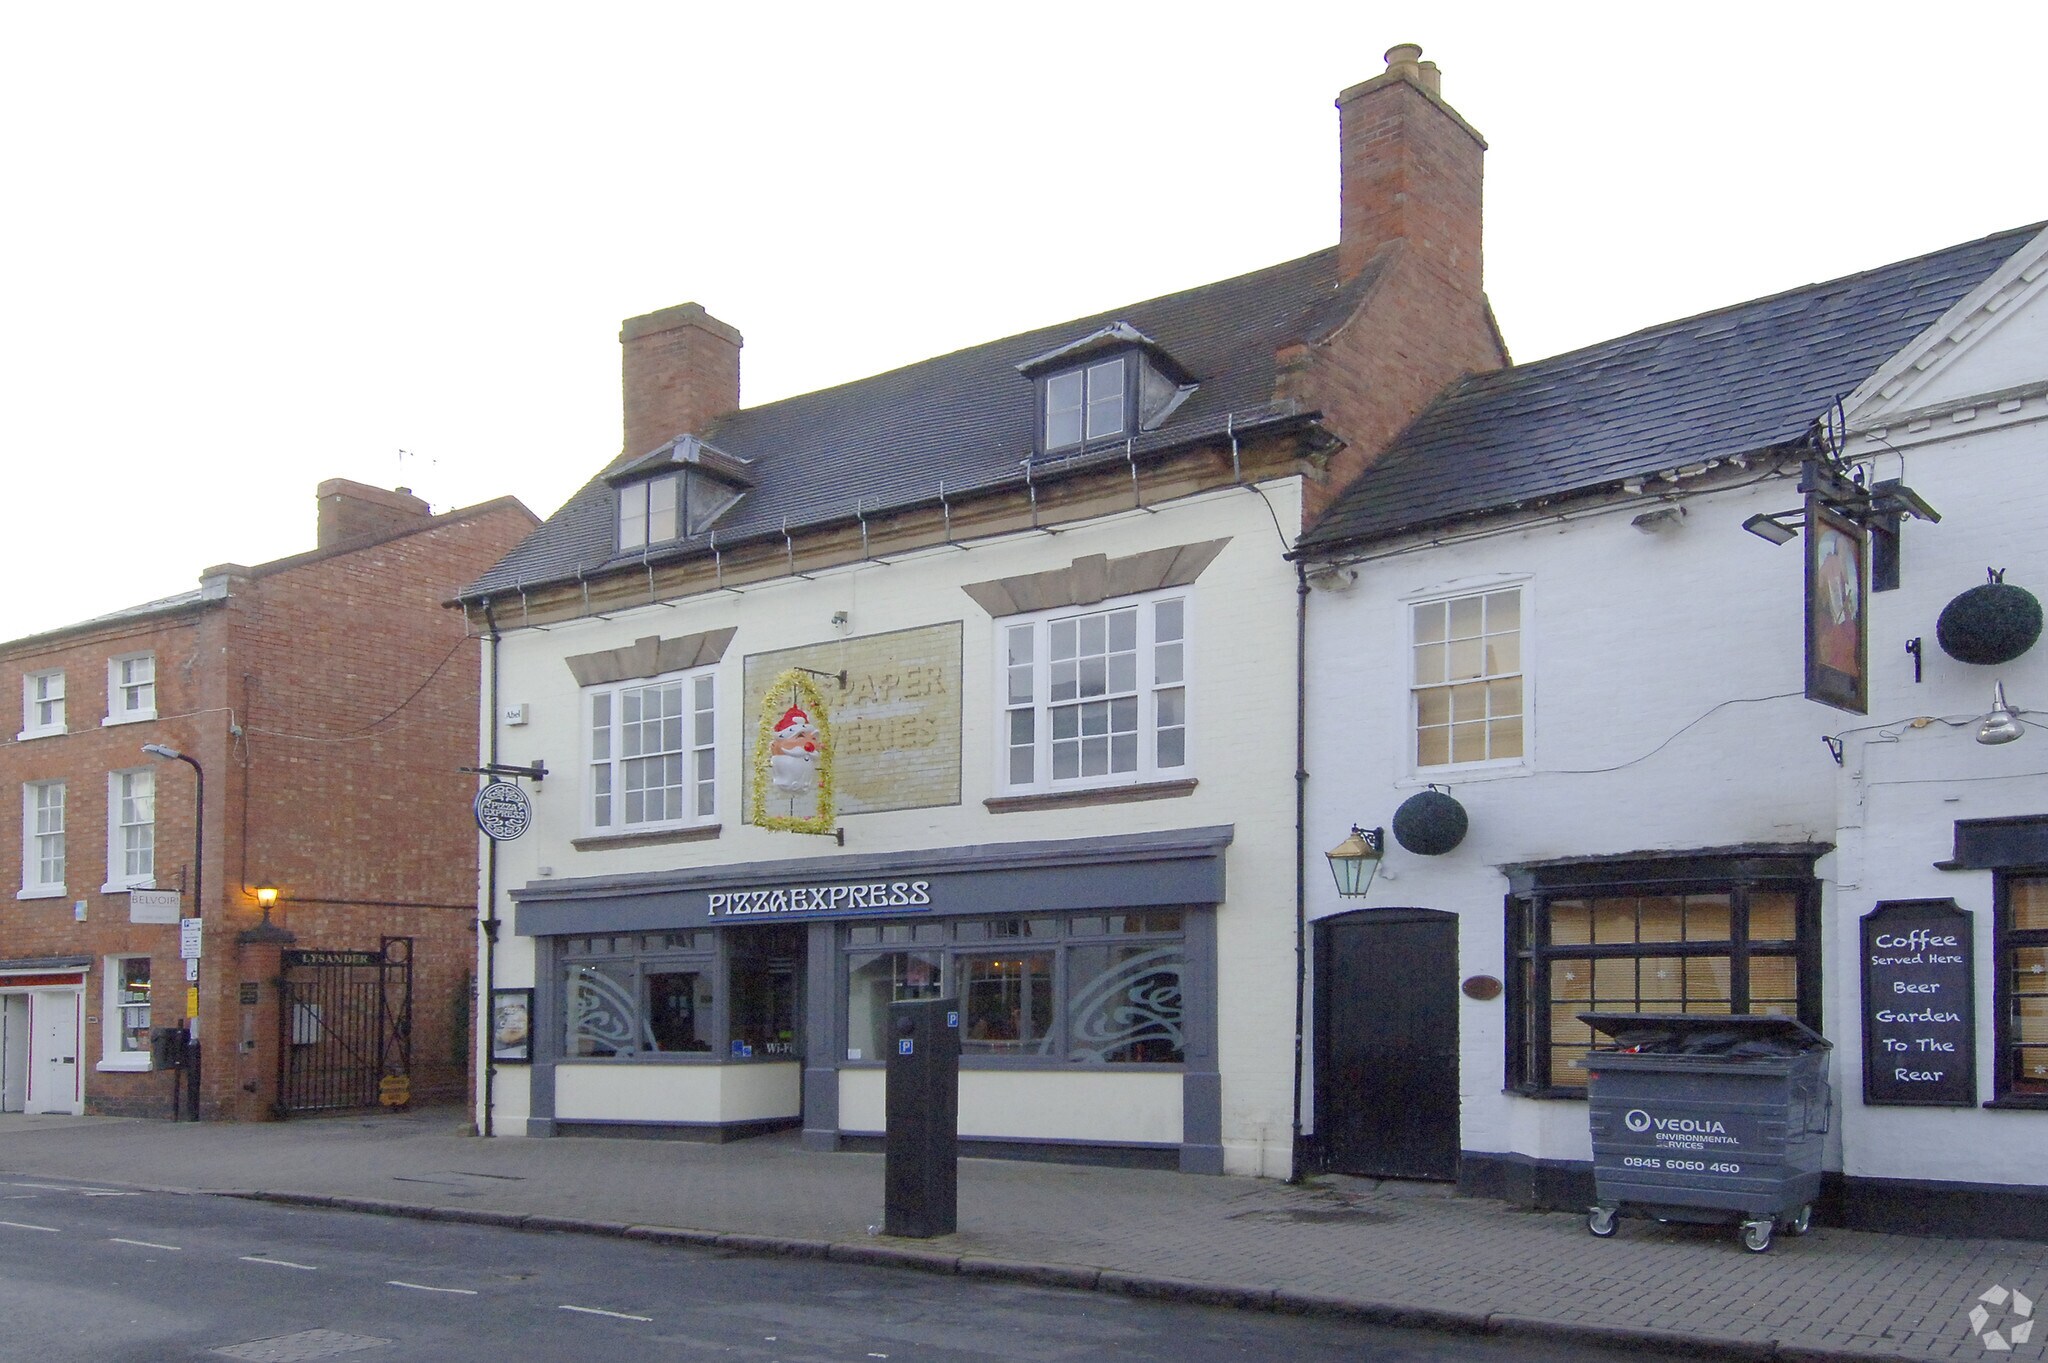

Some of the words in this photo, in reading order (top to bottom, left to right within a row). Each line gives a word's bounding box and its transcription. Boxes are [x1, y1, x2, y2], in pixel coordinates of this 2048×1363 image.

[506, 710, 521, 719] Abel
[491, 801, 517, 811] PIZZA
[483, 809, 525, 819] EXPRESS
[1875, 929, 1957, 951] Coffee
[302, 953, 369, 964] LYSANDER
[1871, 953, 1923, 966] Served
[1929, 953, 1963, 964] Here
[1893, 981, 1940, 994] Beer
[1875, 1007, 1960, 1023] Garden
[1882, 1038, 1908, 1052] To
[1915, 1038, 1955, 1052] The
[1894, 1067, 1944, 1082] Rear
[1653, 1118, 1726, 1134] VEOLIA
[1655, 1132, 1740, 1145] ENVIRONMENTAL
[1623, 1157, 1661, 1168] 0845
[1665, 1159, 1705, 1171] 6060
[1709, 1162, 1740, 1173] 460
